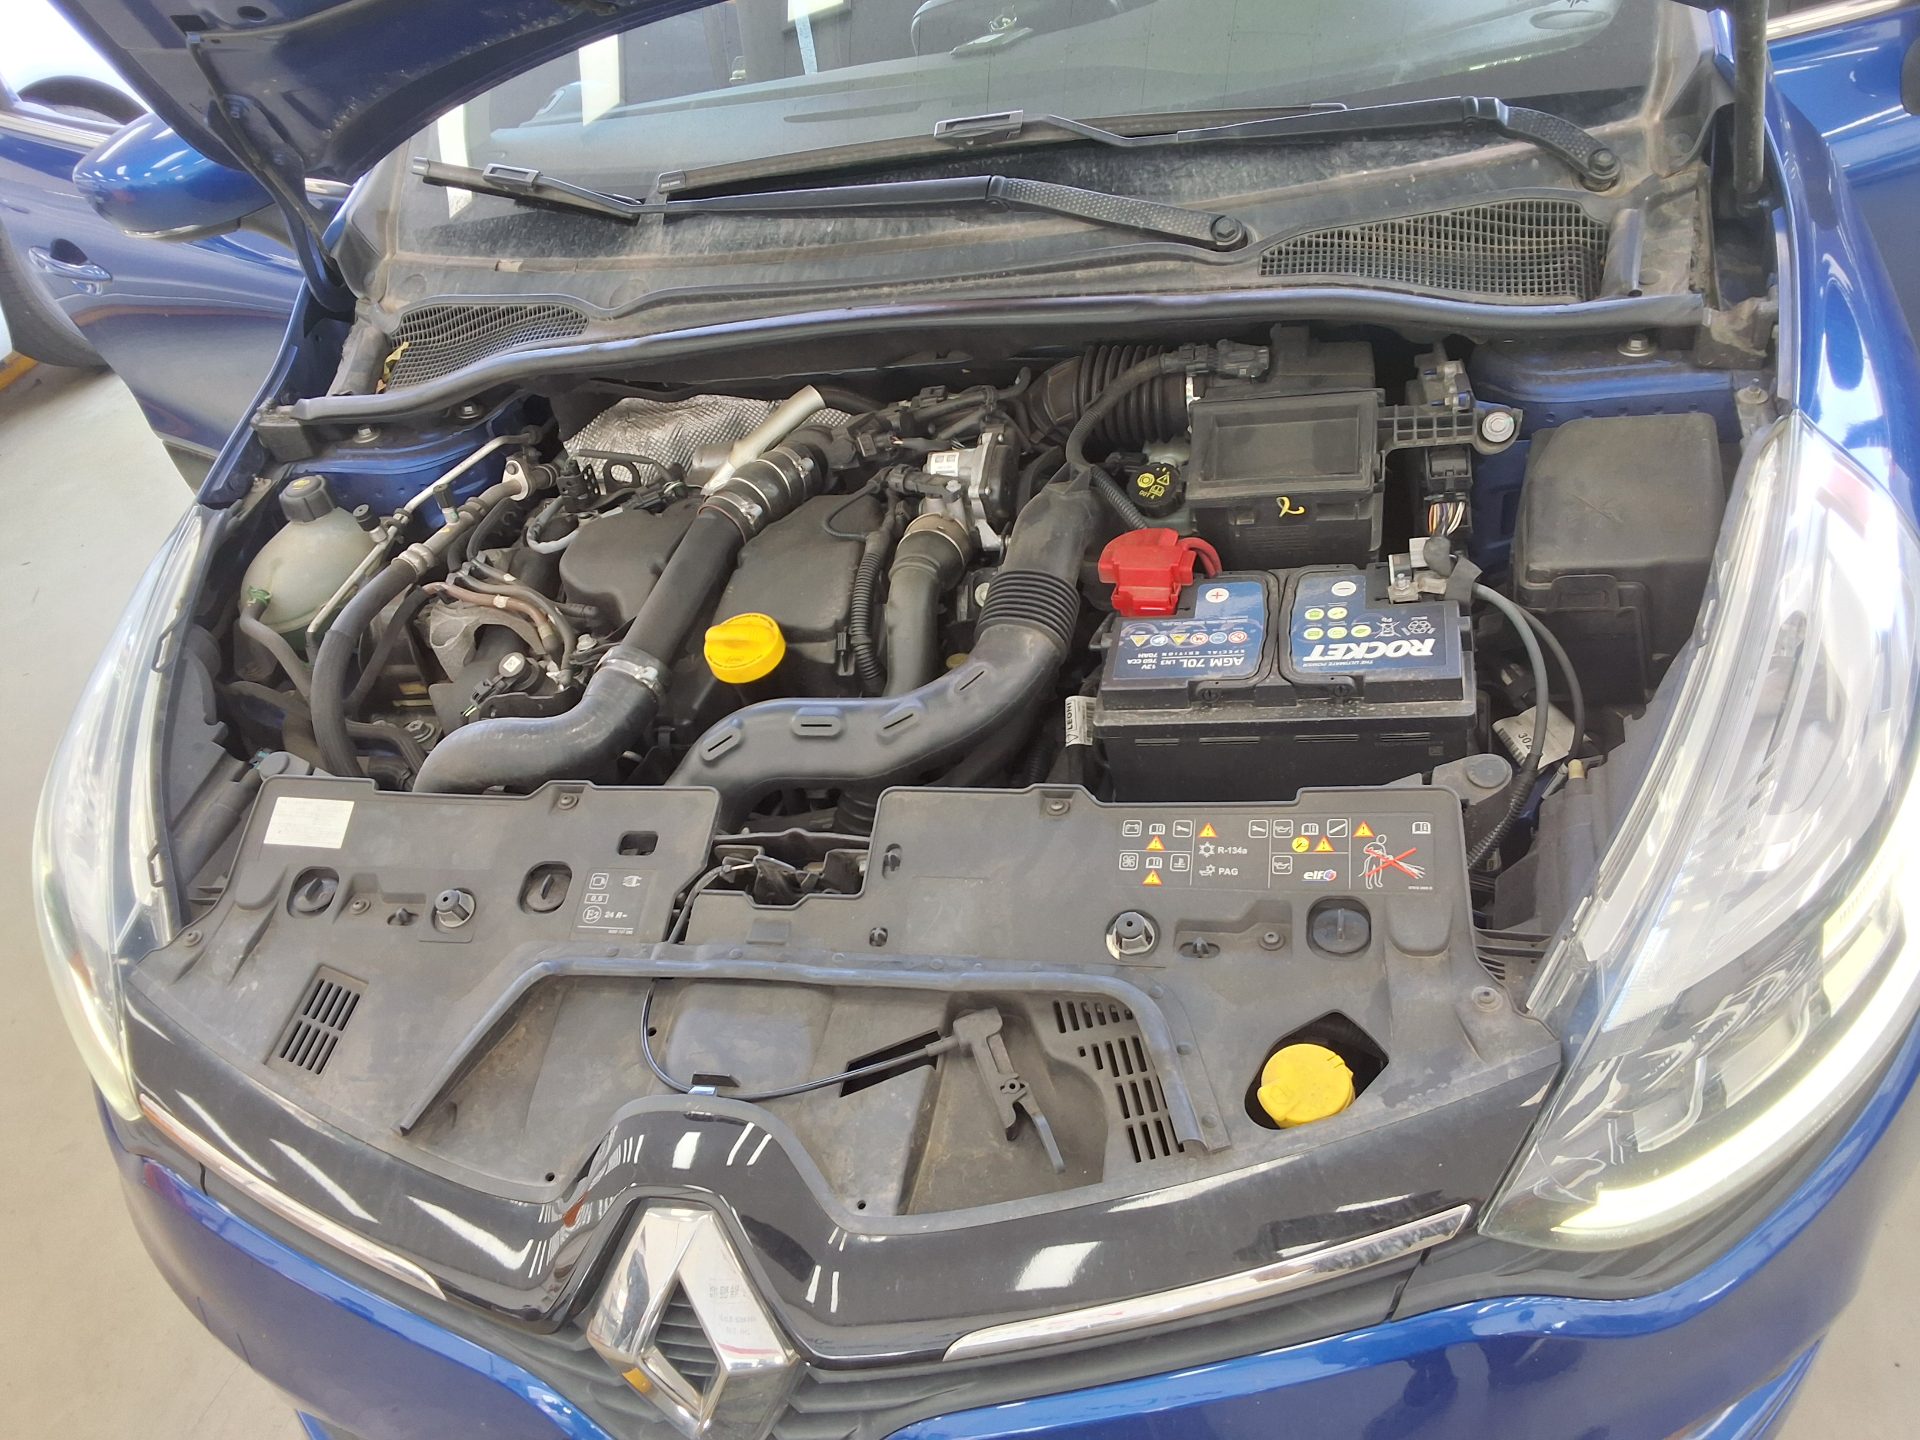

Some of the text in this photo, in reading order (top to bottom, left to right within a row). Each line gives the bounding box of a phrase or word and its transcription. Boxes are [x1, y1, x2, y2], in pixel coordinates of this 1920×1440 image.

[1302, 638, 1436, 662] ROCKET
[1182, 657, 1207, 668] 70L
[1210, 656, 1245, 667] AGM
[1217, 846, 1248, 855] R-134a
[1218, 867, 1239, 876] PAG
[1303, 870, 1325, 880] elf
